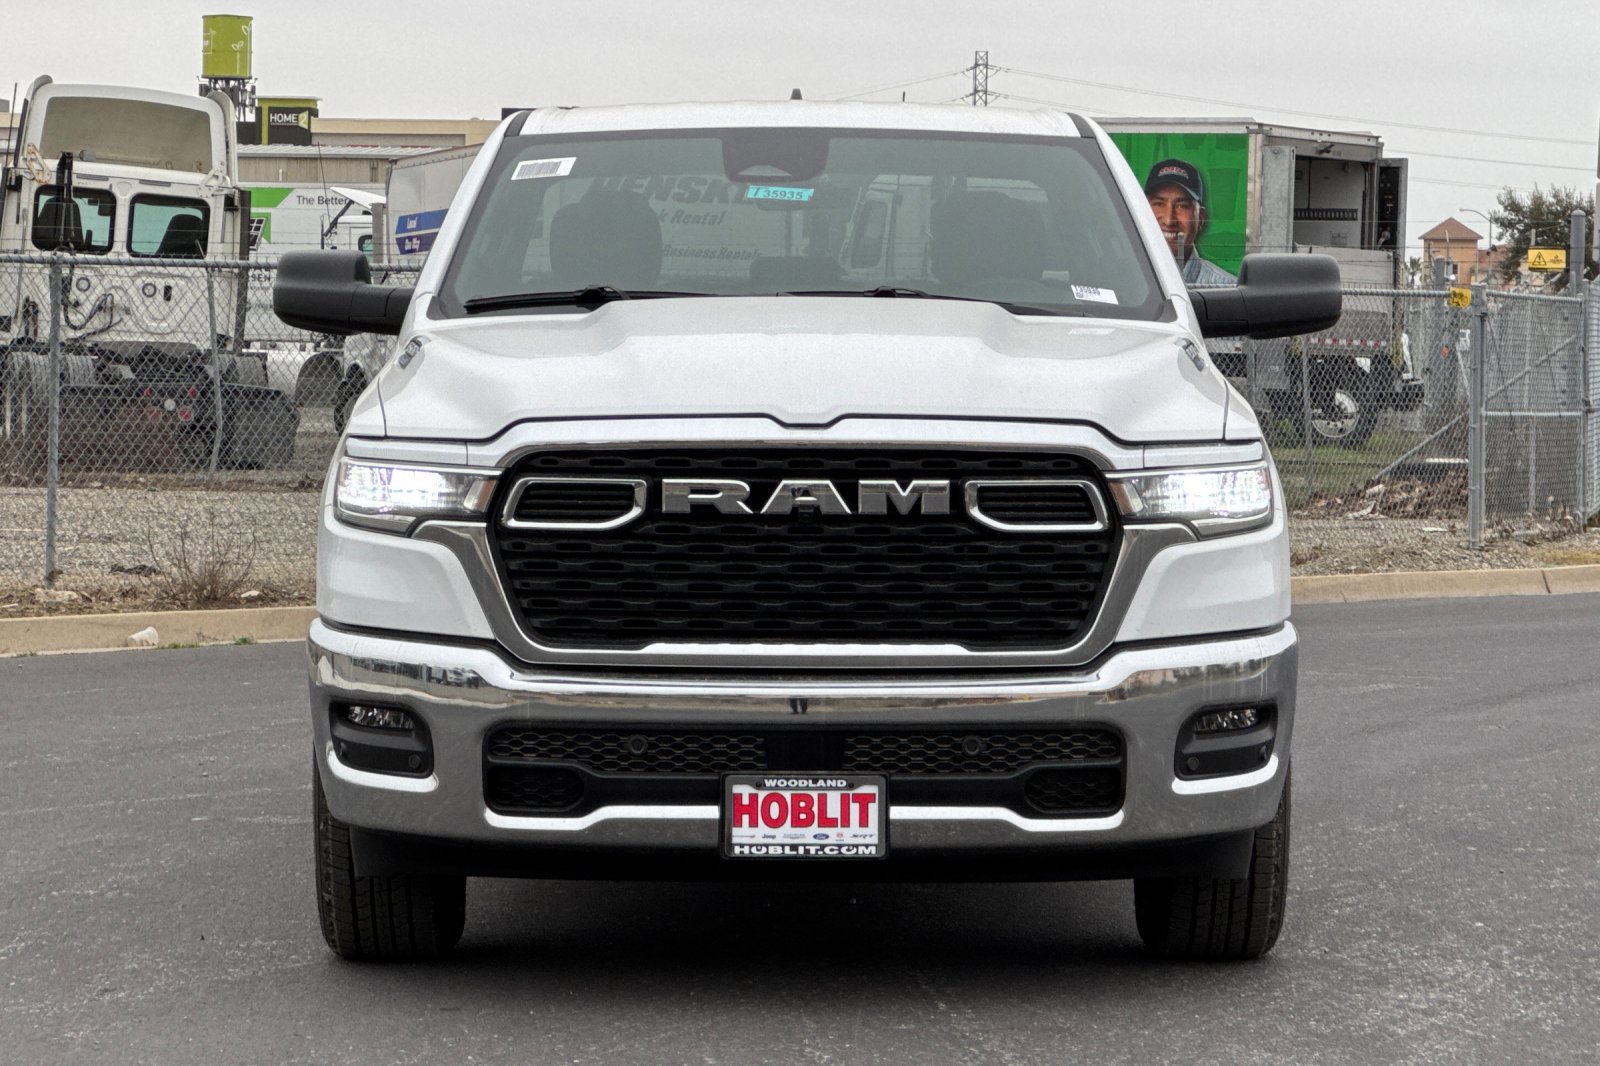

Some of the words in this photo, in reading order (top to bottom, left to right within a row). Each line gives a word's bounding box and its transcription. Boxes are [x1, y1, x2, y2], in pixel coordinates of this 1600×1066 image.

[296, 194, 315, 205] The
[317, 195, 349, 206] Better
[670, 208, 727, 226] Rental
[663, 243, 717, 259] Business
[661, 478, 951, 515] RAM
[764, 778, 847, 788] WOODLAND
[732, 792, 877, 829] HOBLIT
[734, 845, 877, 855] HOBLIT.COM
